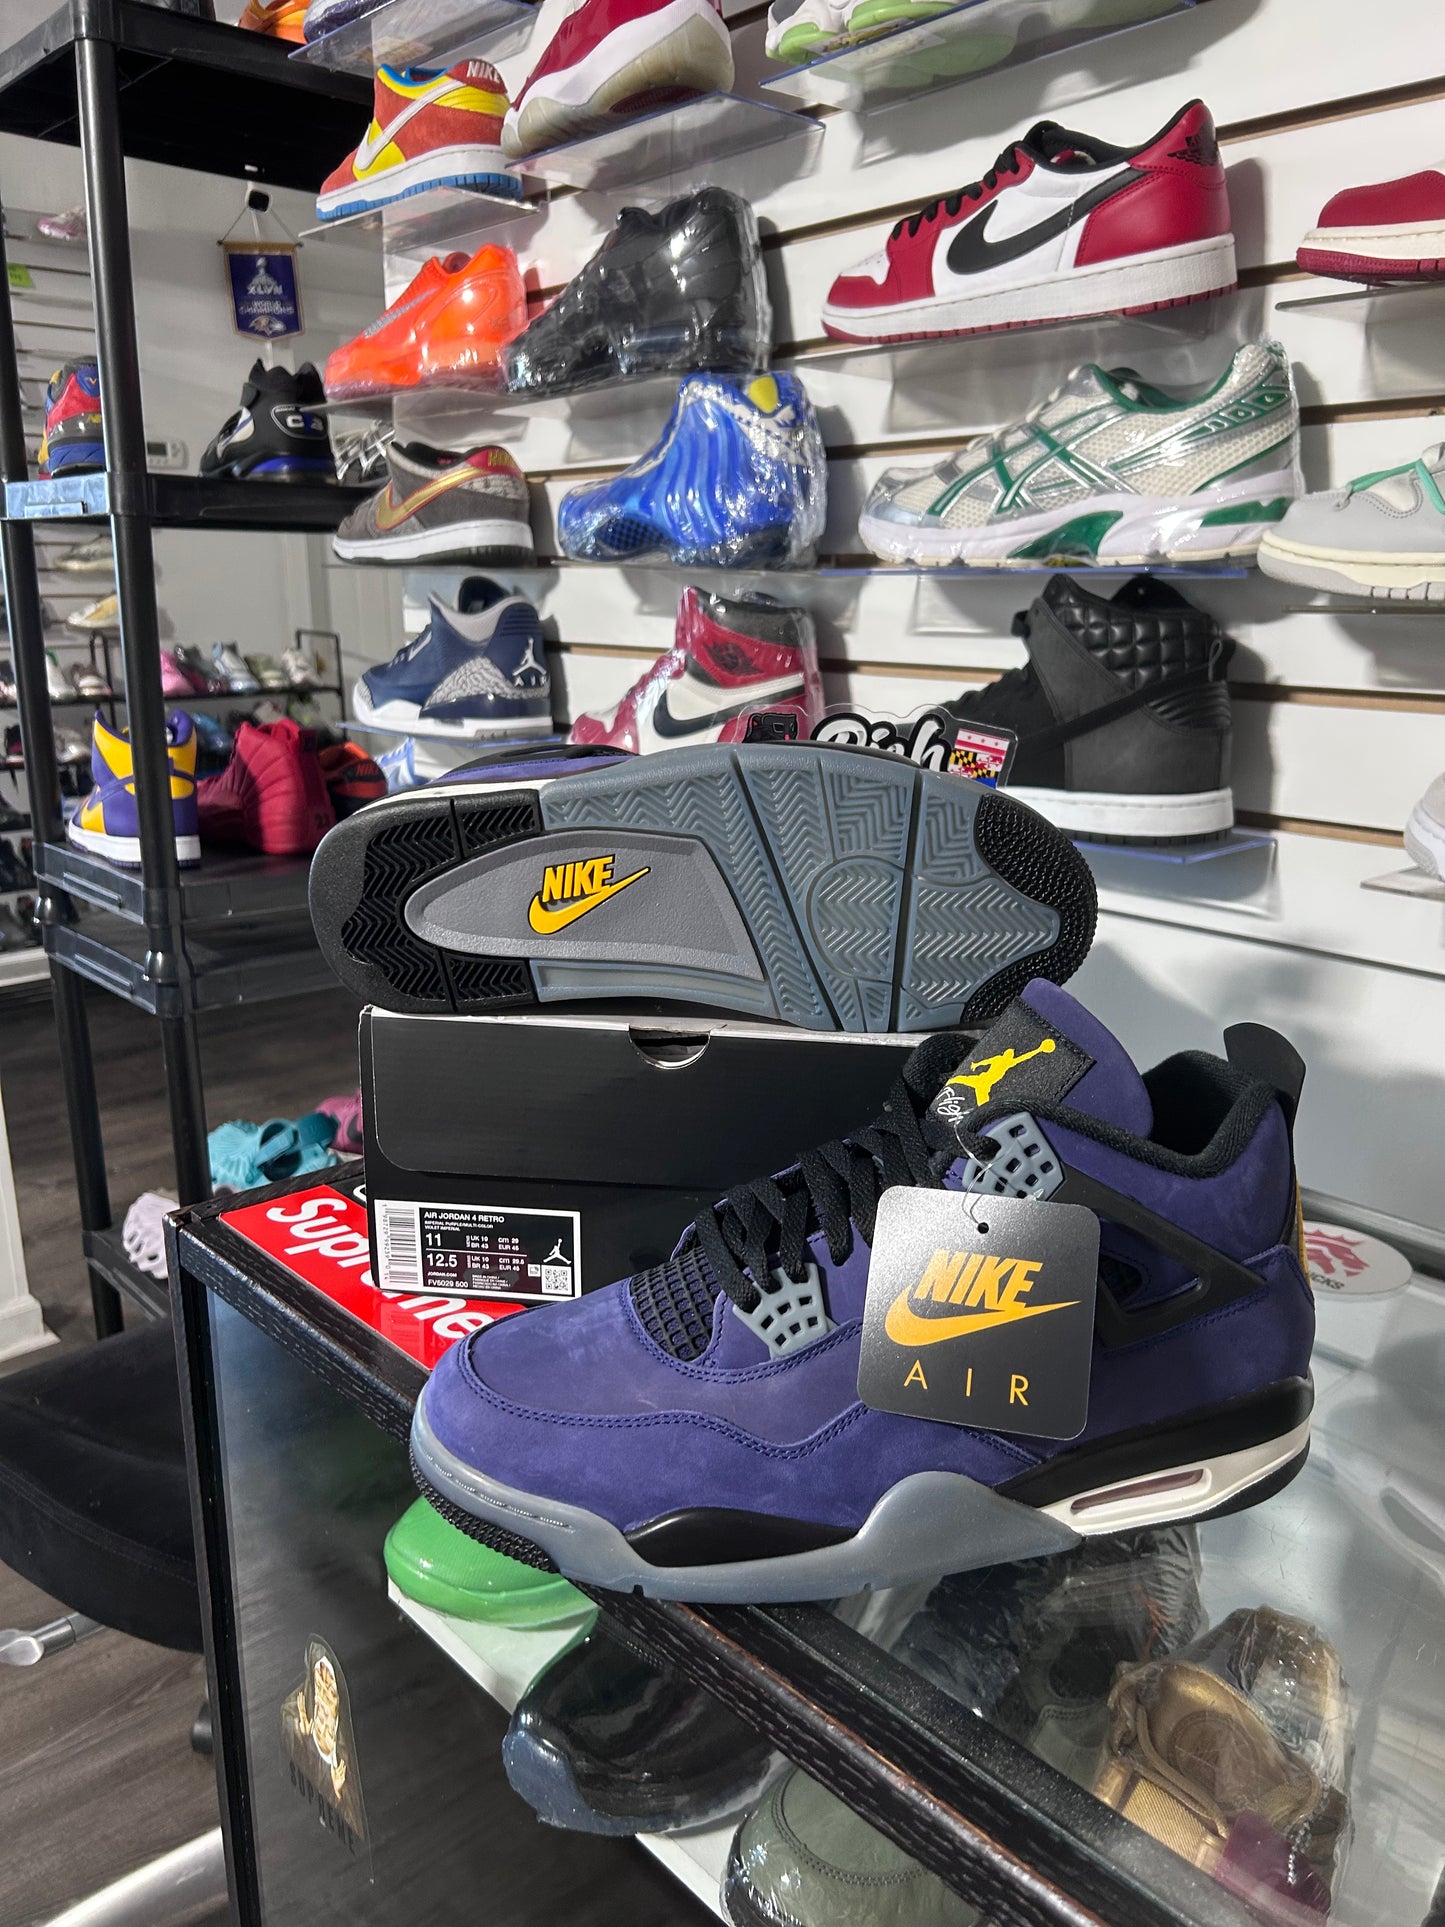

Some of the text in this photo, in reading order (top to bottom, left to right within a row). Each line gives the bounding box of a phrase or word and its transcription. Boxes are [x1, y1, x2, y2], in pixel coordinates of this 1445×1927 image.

[466, 61, 500, 83] NIKE
[542, 854, 615, 903] NIKE
[424, 1211, 437, 1219] AIR
[439, 1212, 470, 1221] JORDAN
[478, 1214, 505, 1223] RETRO
[425, 1232, 442, 1247] 11
[266, 1198, 495, 1339] Suprme
[427, 1252, 458, 1267] 12.5
[428, 1279, 454, 1287] FV5029
[455, 1280, 469, 1288] 500
[913, 1249, 1044, 1311] NIKE
[904, 1360, 1029, 1406] AIR
